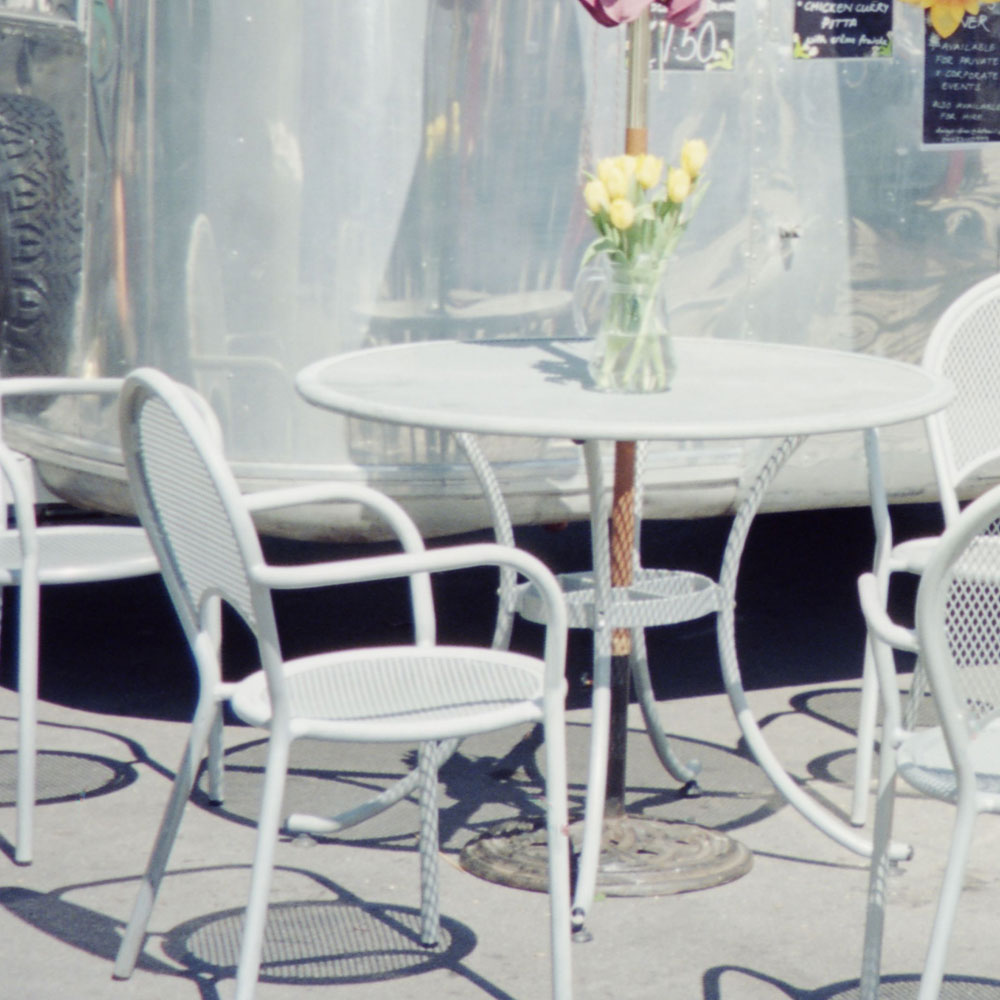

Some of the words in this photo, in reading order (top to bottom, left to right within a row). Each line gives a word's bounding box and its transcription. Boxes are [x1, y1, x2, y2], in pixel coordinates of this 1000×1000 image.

[804, 0, 853, 14] CHICKEN
[855, 3, 890, 14] CURRY
[820, 16, 858, 30] PITTA
[941, 42, 997, 52] AVAILABLE
[935, 55, 953, 65] FOR
[959, 55, 999, 66] PRIVATE
[945, 69, 999, 81] CORPORATE
[941, 83, 982, 92] EVENTS
